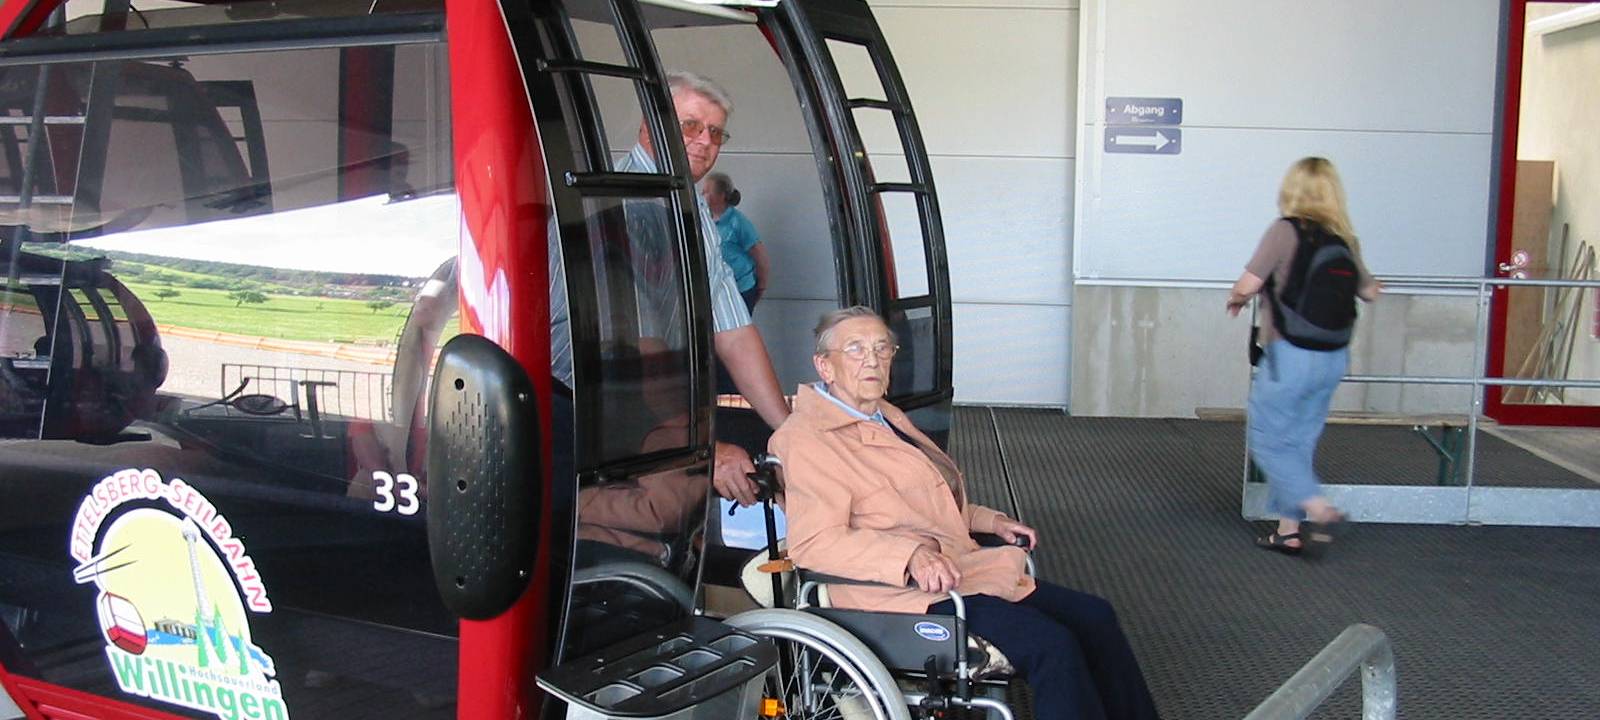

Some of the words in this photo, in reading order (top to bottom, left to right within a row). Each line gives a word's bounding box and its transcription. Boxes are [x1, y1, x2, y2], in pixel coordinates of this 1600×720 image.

[1123, 104, 1165, 117] Abgang
[372, 470, 420, 516] 33
[111, 651, 285, 720] Willingen
